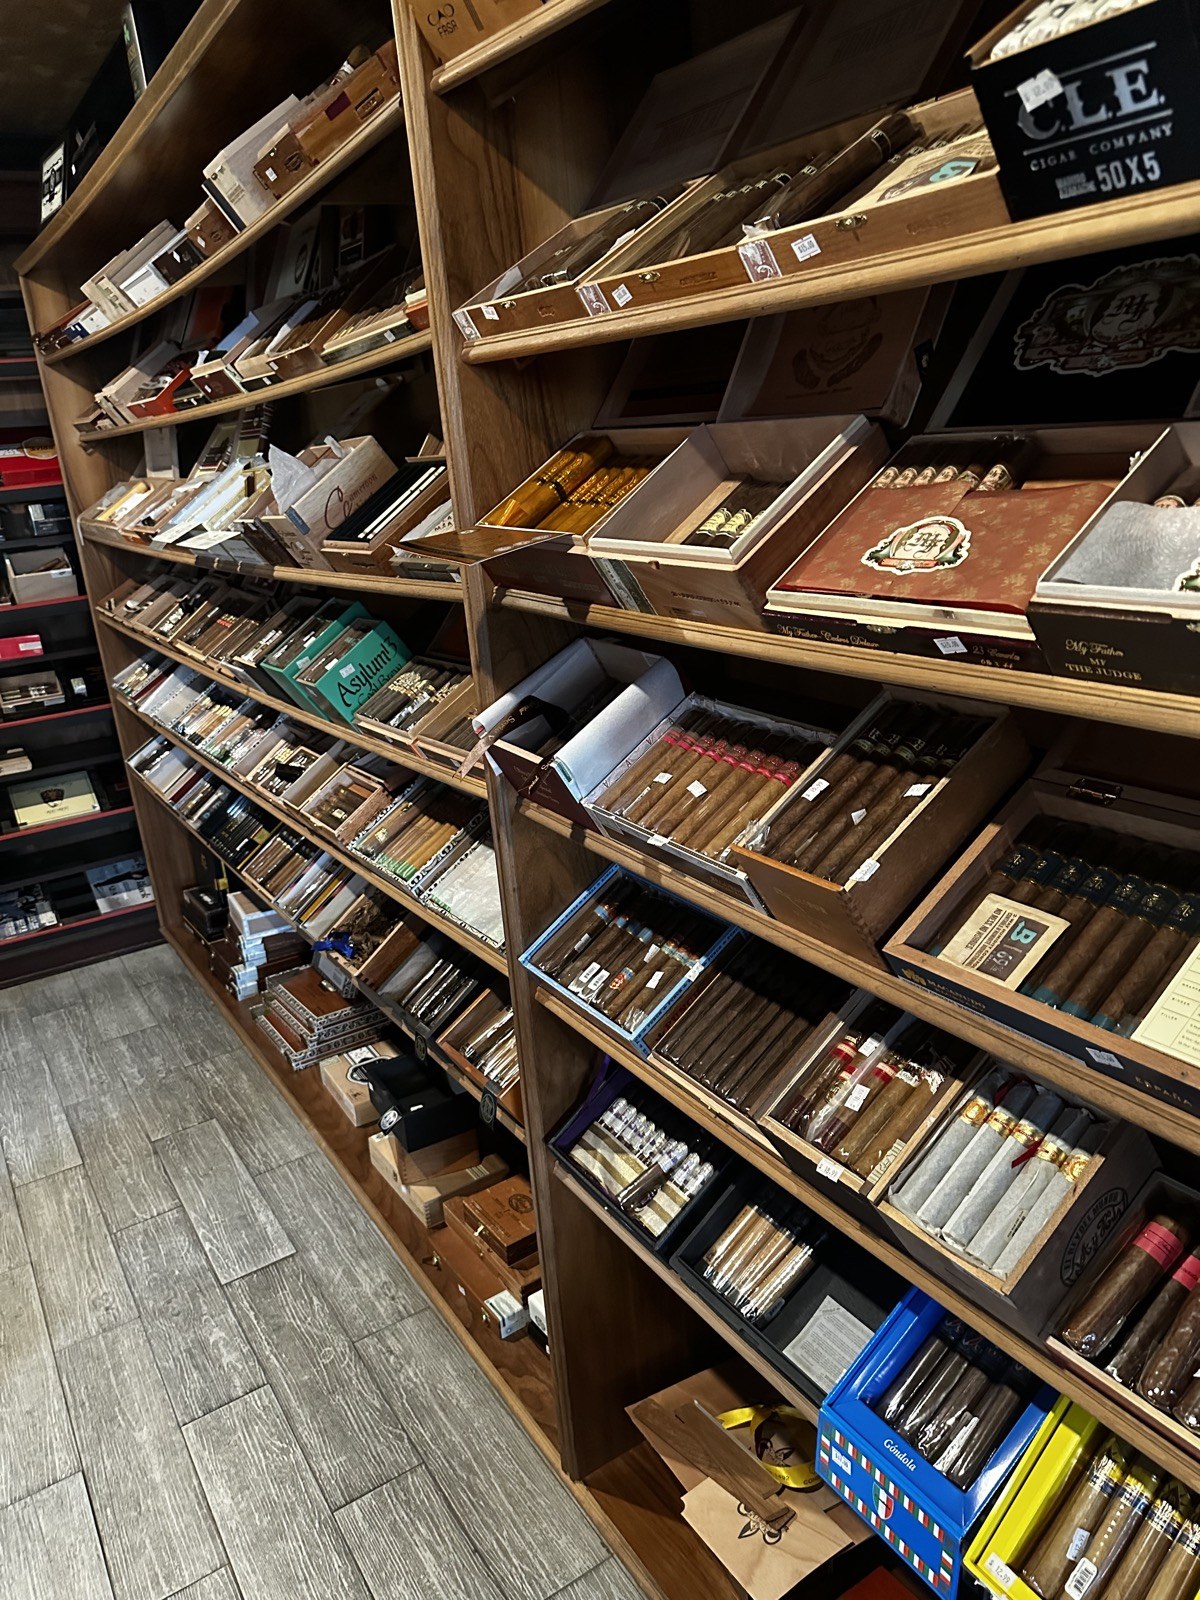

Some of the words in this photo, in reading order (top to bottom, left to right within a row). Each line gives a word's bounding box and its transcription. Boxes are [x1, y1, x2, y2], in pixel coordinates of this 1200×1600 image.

[1029, 149, 1077, 171] CIGAR
[1089, 122, 1173, 155] COMPANY
[1065, 639, 1088, 655] My
[1089, 642, 1124, 657] Father
[1065, 663, 1093, 674] THE
[1096, 668, 1142, 680] JUDGE
[884, 1439, 916, 1472] Góndola
[995, 1564, 1011, 1584] 12.99
